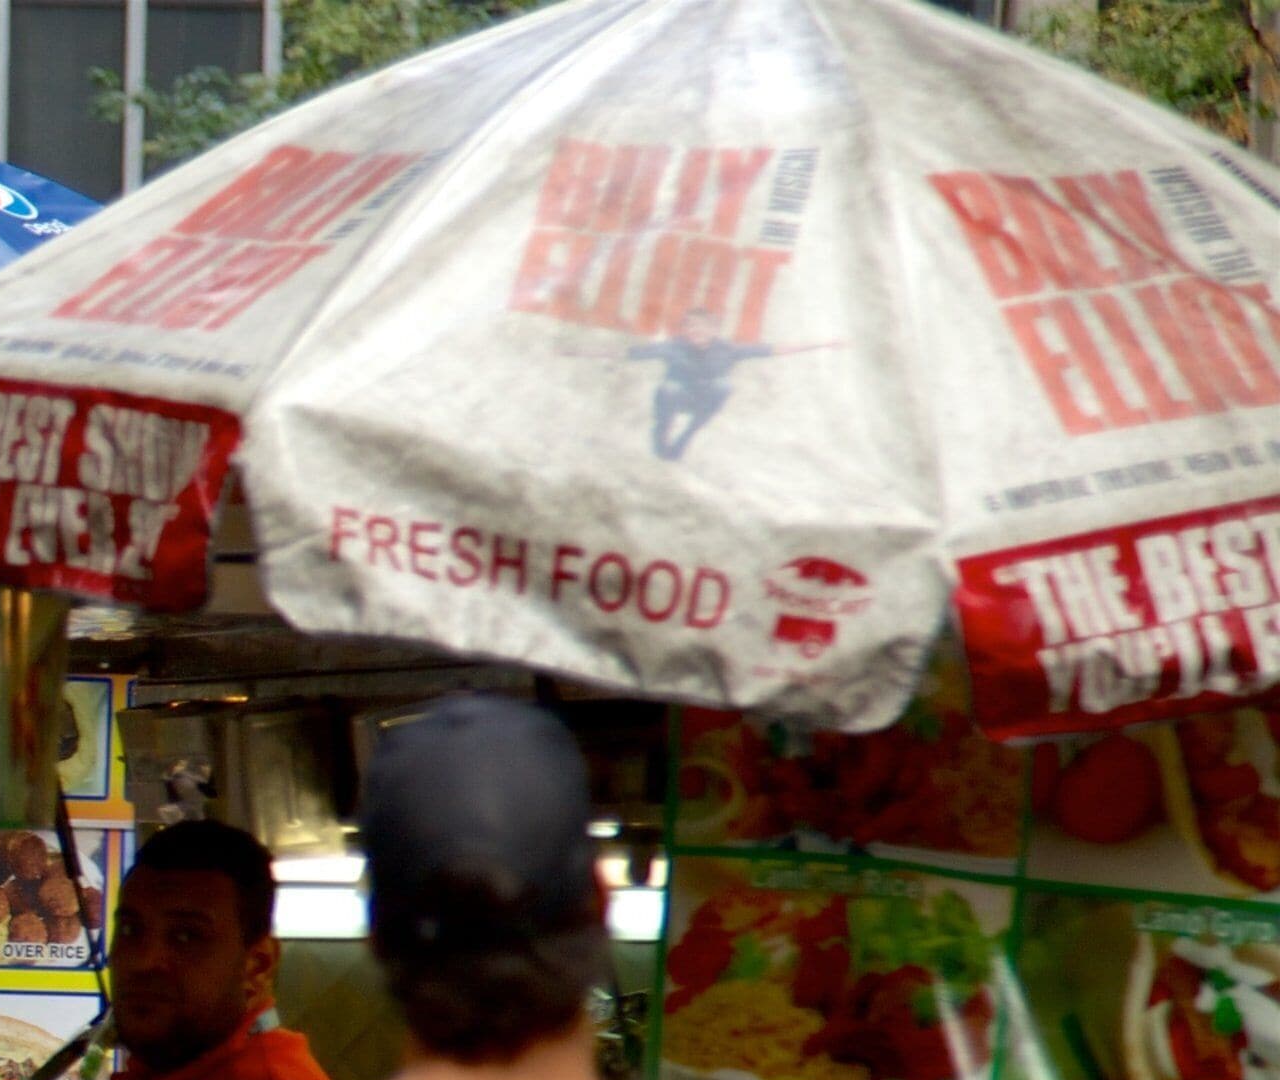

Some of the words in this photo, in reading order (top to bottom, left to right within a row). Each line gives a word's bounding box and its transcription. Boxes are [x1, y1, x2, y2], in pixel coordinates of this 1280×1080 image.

[329, 505, 531, 596] FRESH
[547, 542, 732, 630] FOOD
[992, 543, 1145, 645] THE
[3, 944, 44, 960] OVER
[49, 945, 85, 960] RICE
